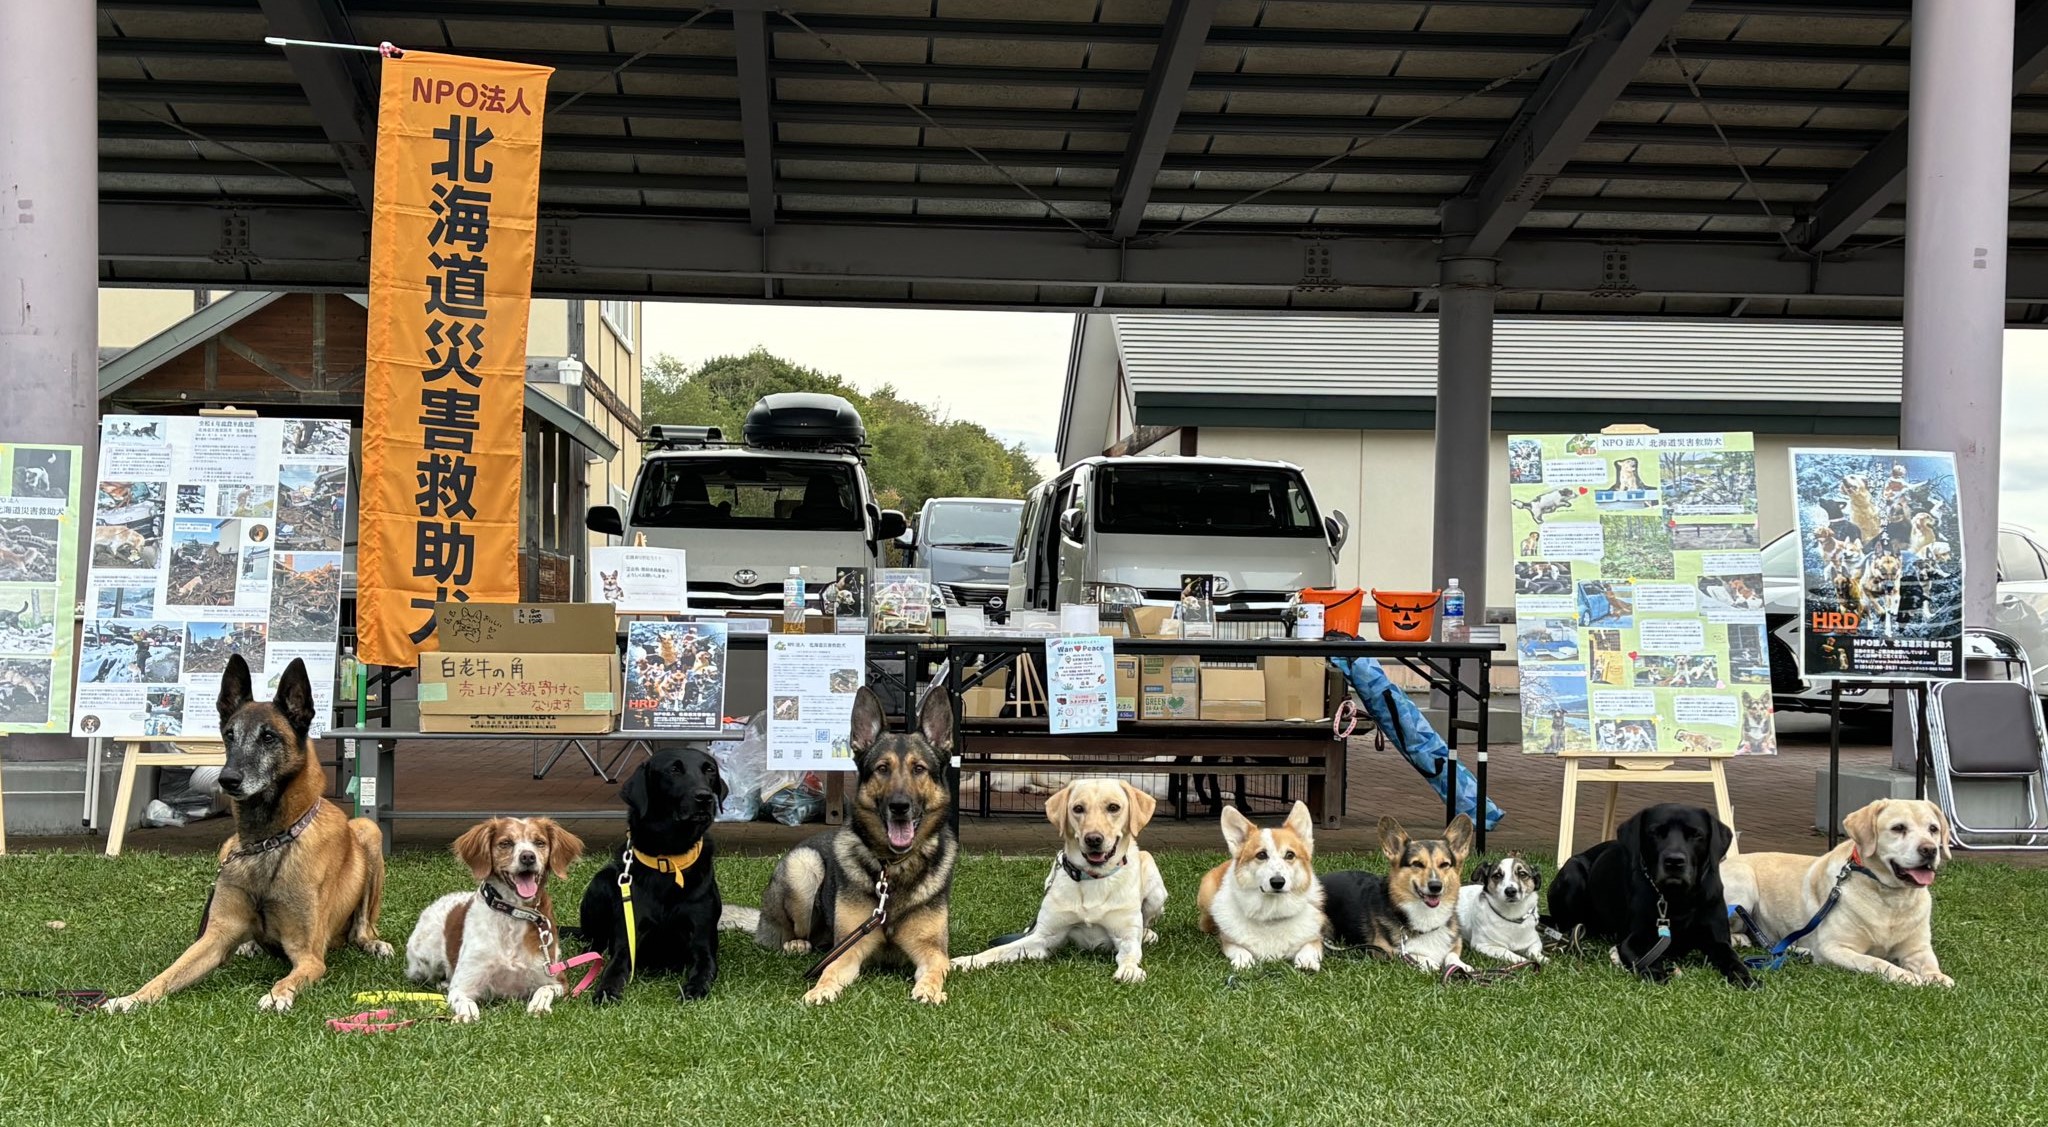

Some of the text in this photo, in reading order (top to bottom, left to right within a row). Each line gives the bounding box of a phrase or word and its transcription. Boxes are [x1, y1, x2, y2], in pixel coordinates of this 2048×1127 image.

[411, 76, 532, 117] NPO法人
[1602, 437, 1722, 448] NPO 法人 北海道災害救助犬
[1812, 611, 1859, 629] HRD
[458, 680, 581, 698] 売上げ全額寄付に
[530, 698, 573, 713] なります
[628, 699, 659, 709] HRD
[1145, 697, 1167, 706] GREEN
